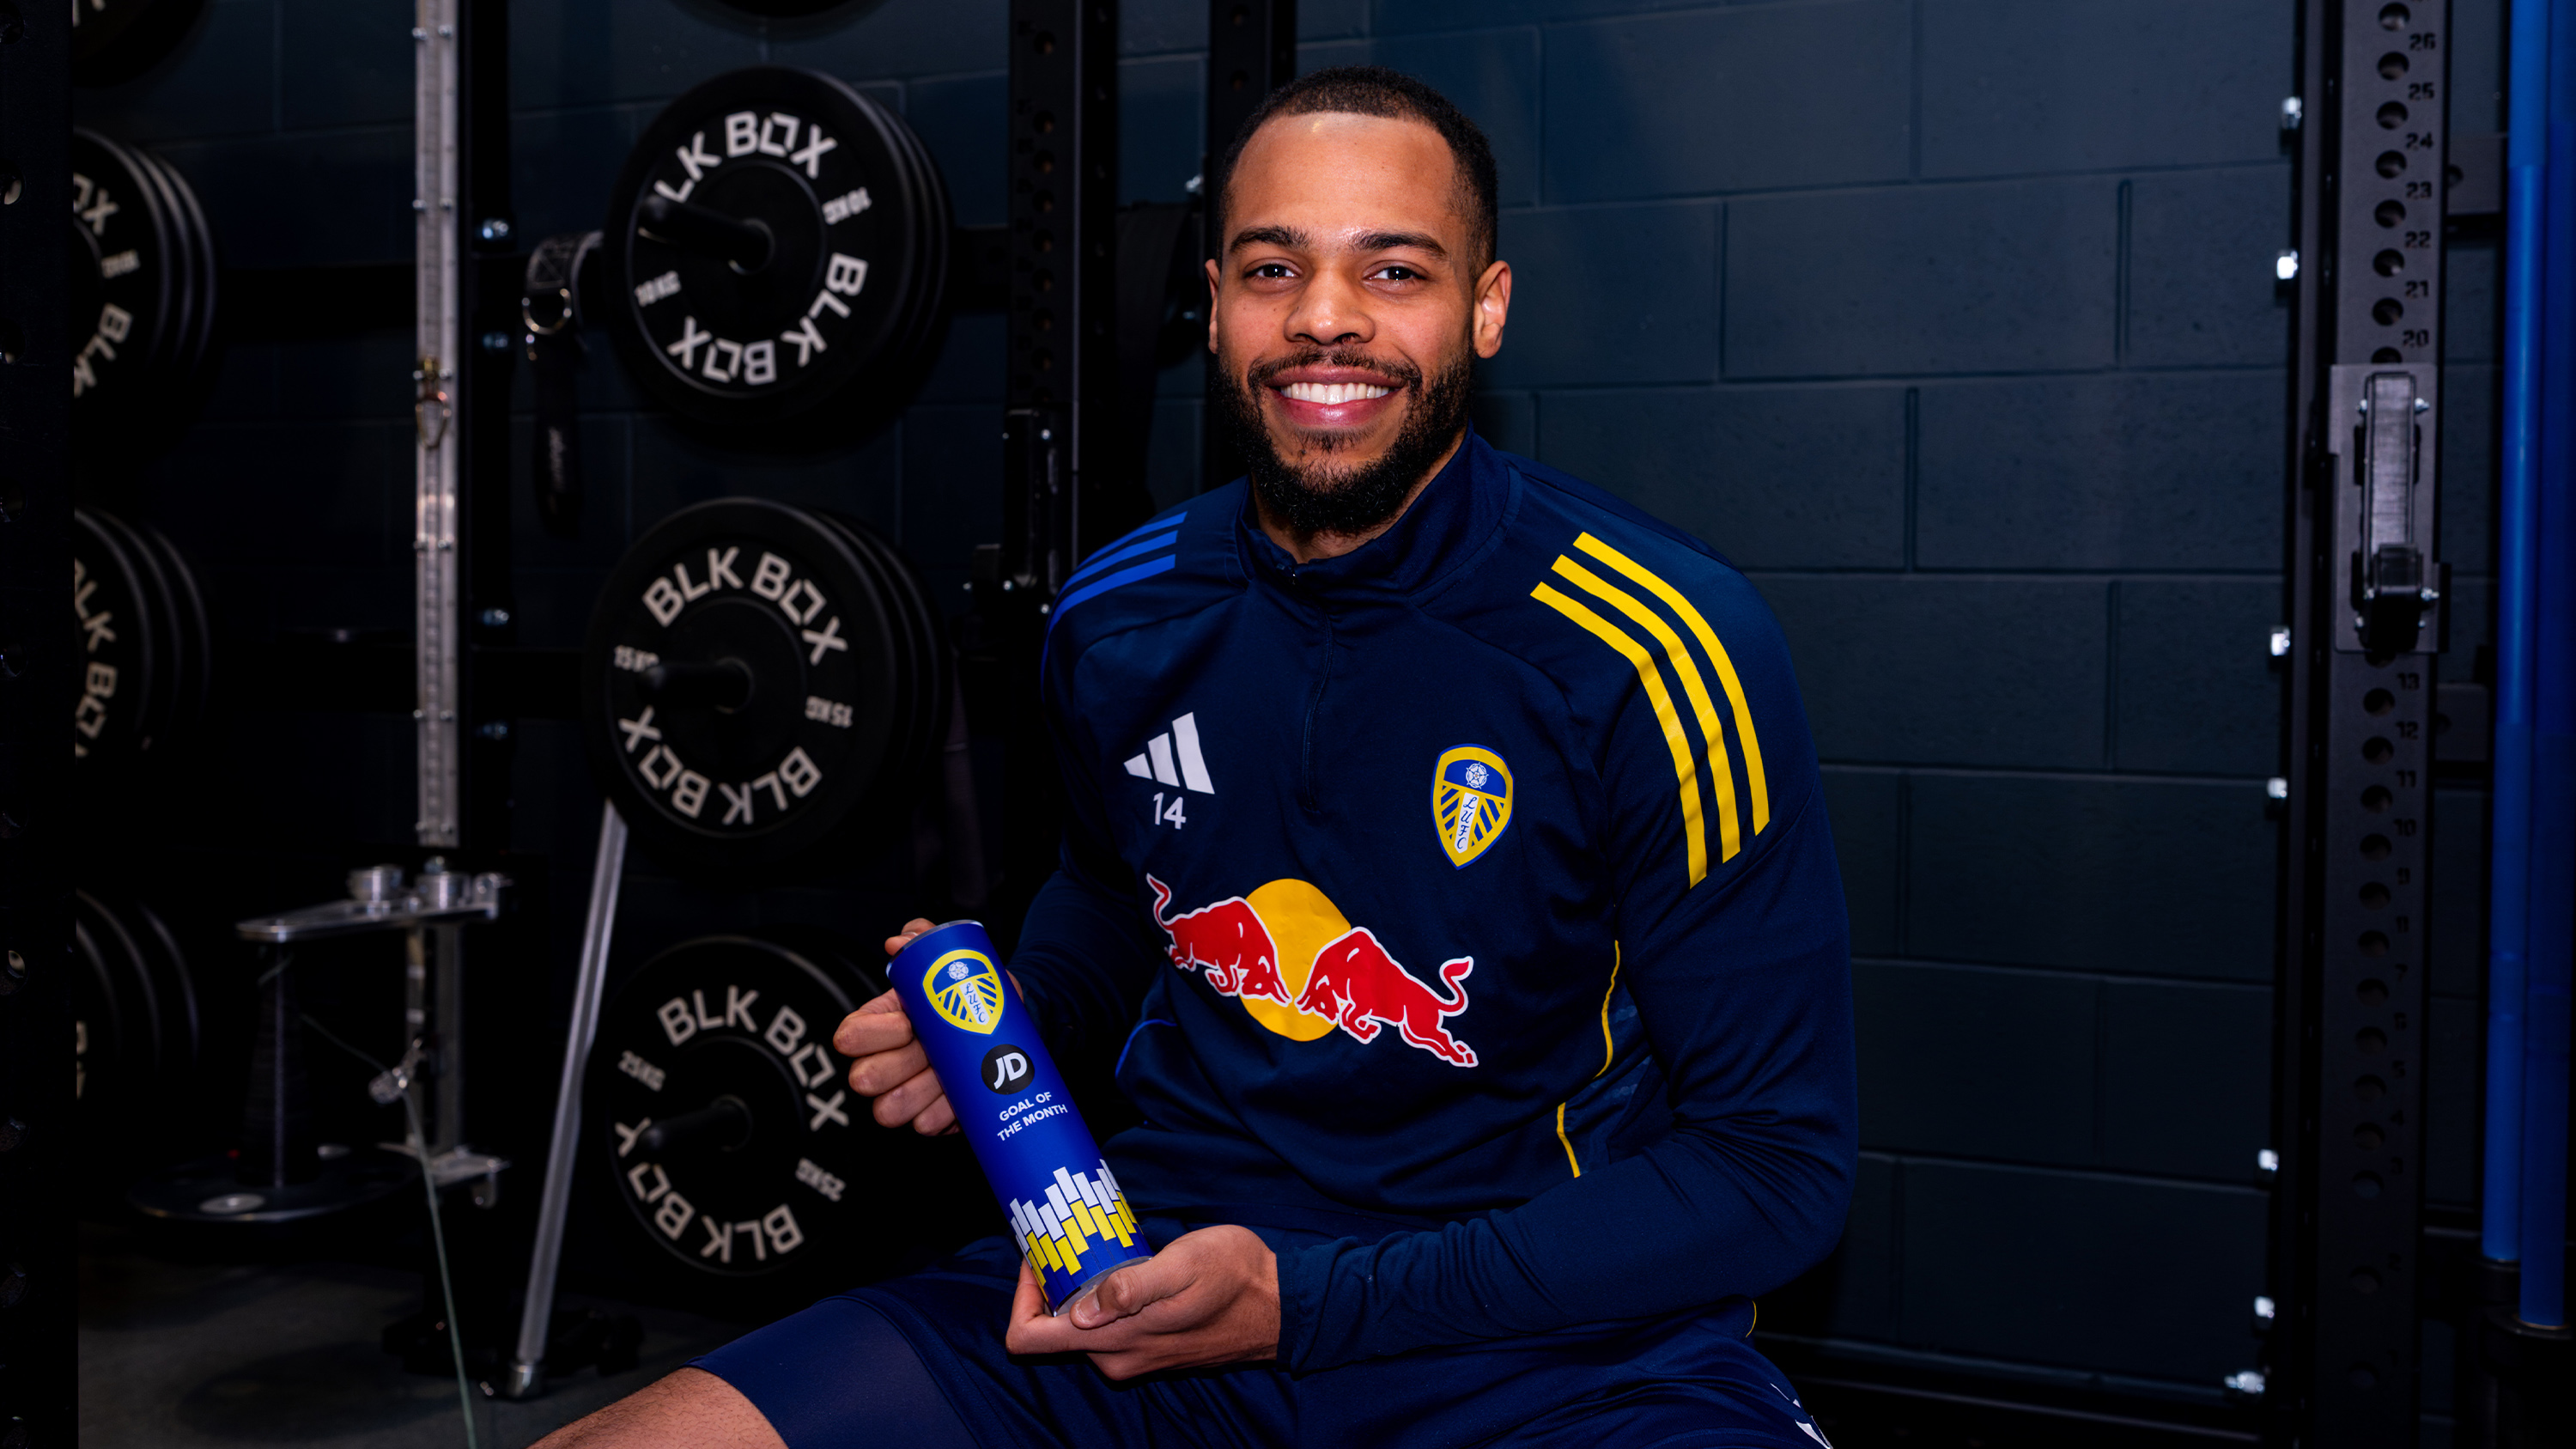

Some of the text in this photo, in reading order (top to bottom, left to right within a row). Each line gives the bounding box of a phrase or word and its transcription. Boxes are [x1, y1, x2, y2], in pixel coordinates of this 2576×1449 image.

[2409, 33, 2437, 52] 26
[2408, 82, 2435, 101] 25
[653, 109, 838, 204] LK BOX
[2405, 131, 2433, 150] 24
[2405, 180, 2433, 199] 23
[2404, 230, 2432, 249] 22
[2404, 280, 2429, 299] 21
[667, 252, 869, 387] BLK BOX
[2402, 329, 2429, 348] 20
[641, 545, 848, 667] BLK BOX
[2397, 673, 2420, 691] 13
[804, 694, 855, 729] 15KG
[2395, 721, 2419, 740] 12
[617, 703, 823, 827] BLK BOX
[2395, 770, 2417, 788] 11
[1152, 790, 1188, 831] 14
[1456, 796, 1477, 849] LUFC
[2393, 819, 2416, 837] 10
[963, 981, 987, 1024] LUFC
[617, 1049, 667, 1093] 25KG
[655, 983, 851, 1133] BLK BOX
[993, 1050, 1028, 1091] JD
[2391, 1060, 2406, 1079] 5
[997, 1102, 1068, 1142] THE MONTH
[998, 1091, 1053, 1123] GOAL OF
[2390, 1110, 2404, 1126] 4
[613, 1116, 805, 1264] BLK BOX
[794, 1156, 848, 1202] 25KG
